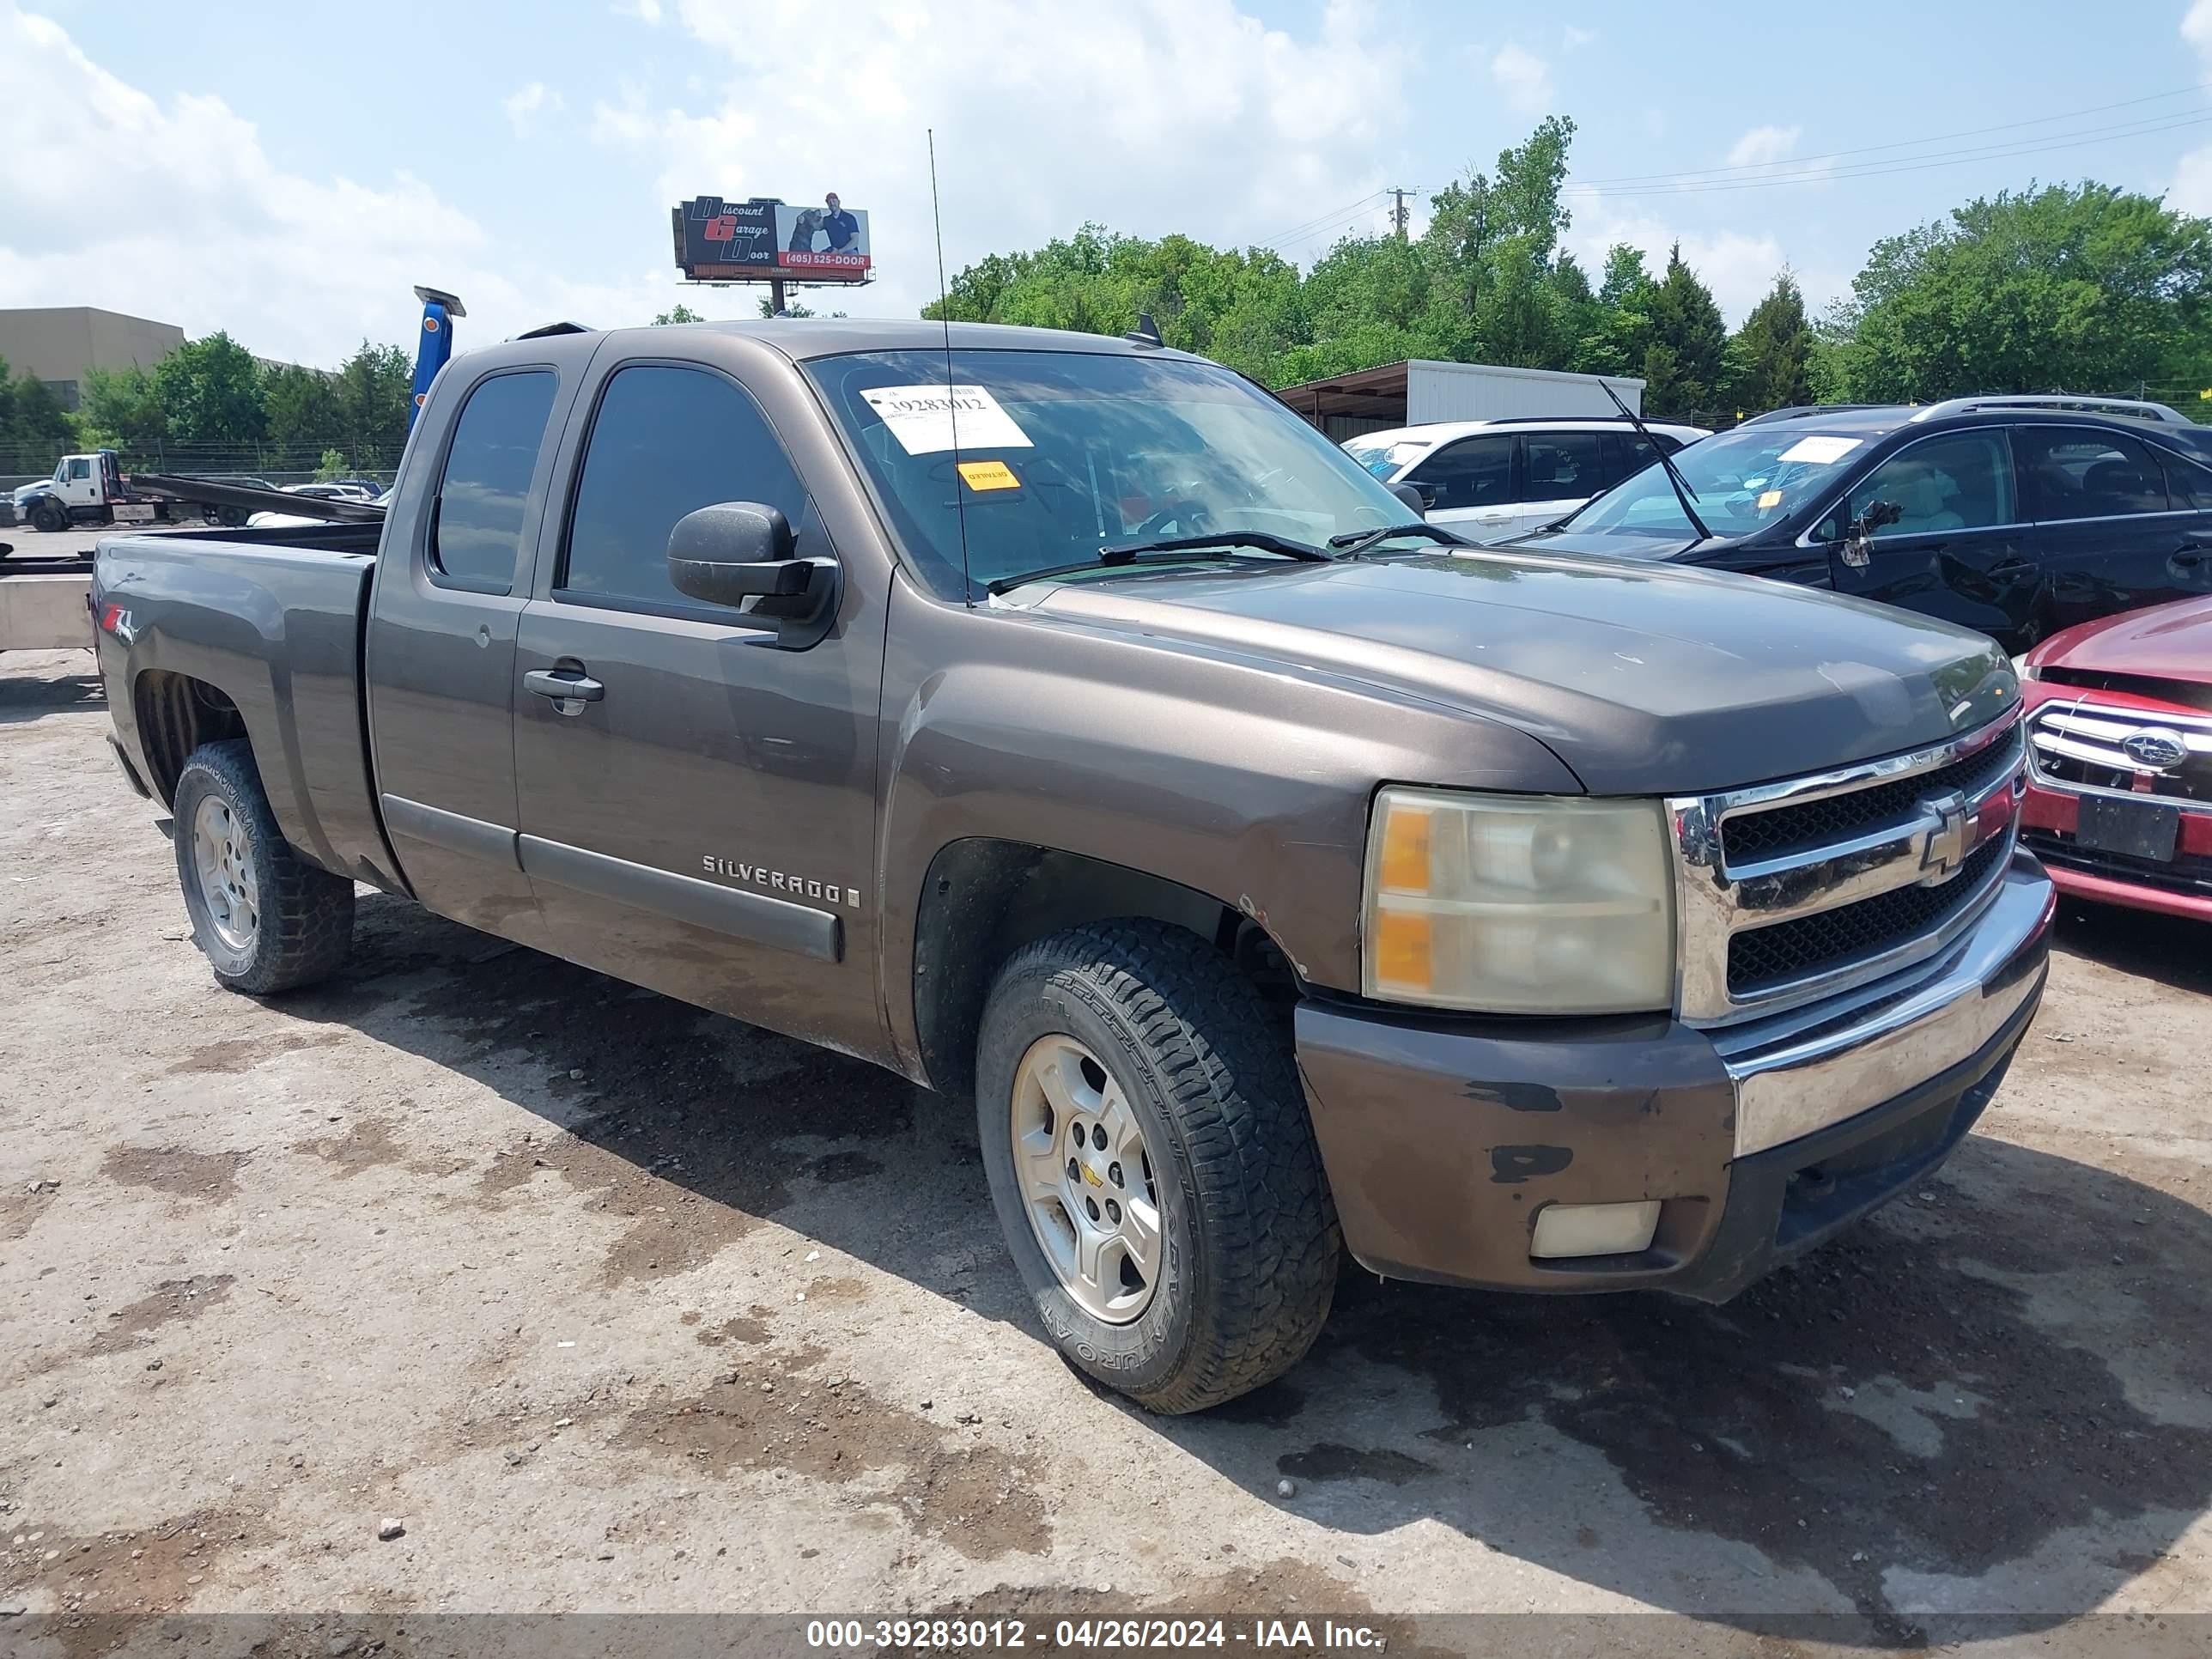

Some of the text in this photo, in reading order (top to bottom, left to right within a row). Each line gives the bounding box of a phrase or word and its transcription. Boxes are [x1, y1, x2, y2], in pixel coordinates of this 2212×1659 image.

[690, 196, 764, 220] Discount
[704, 216, 769, 240] Garage
[720, 236, 770, 262] Door
[786, 253, 866, 266] (405) 525-DOOR
[889, 398, 987, 412] 39283012
[702, 855, 840, 903] SILVERADO
